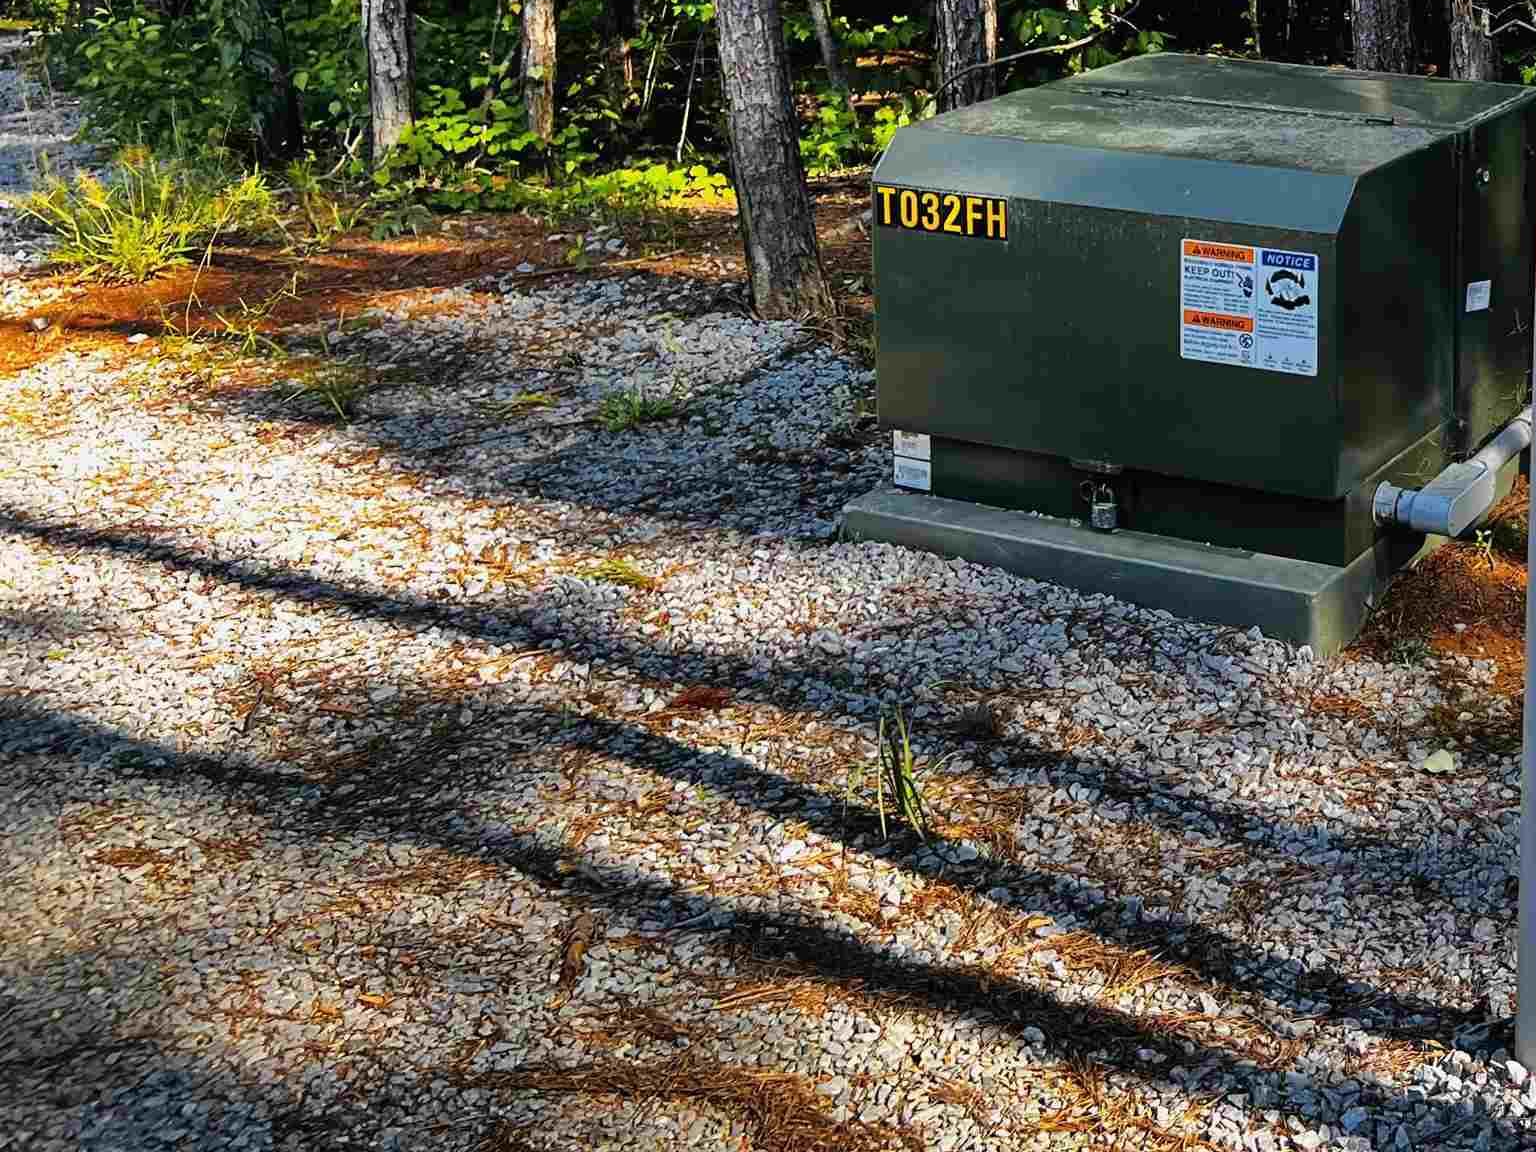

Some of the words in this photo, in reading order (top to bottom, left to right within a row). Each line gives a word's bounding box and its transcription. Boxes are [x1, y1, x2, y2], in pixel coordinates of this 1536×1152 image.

[877, 186, 1006, 239] T032FH
[1200, 246, 1246, 261] WARNING
[1266, 253, 1312, 268] NOTICE
[1184, 264, 1210, 276] KEEP
[1199, 316, 1245, 329] WARNING
